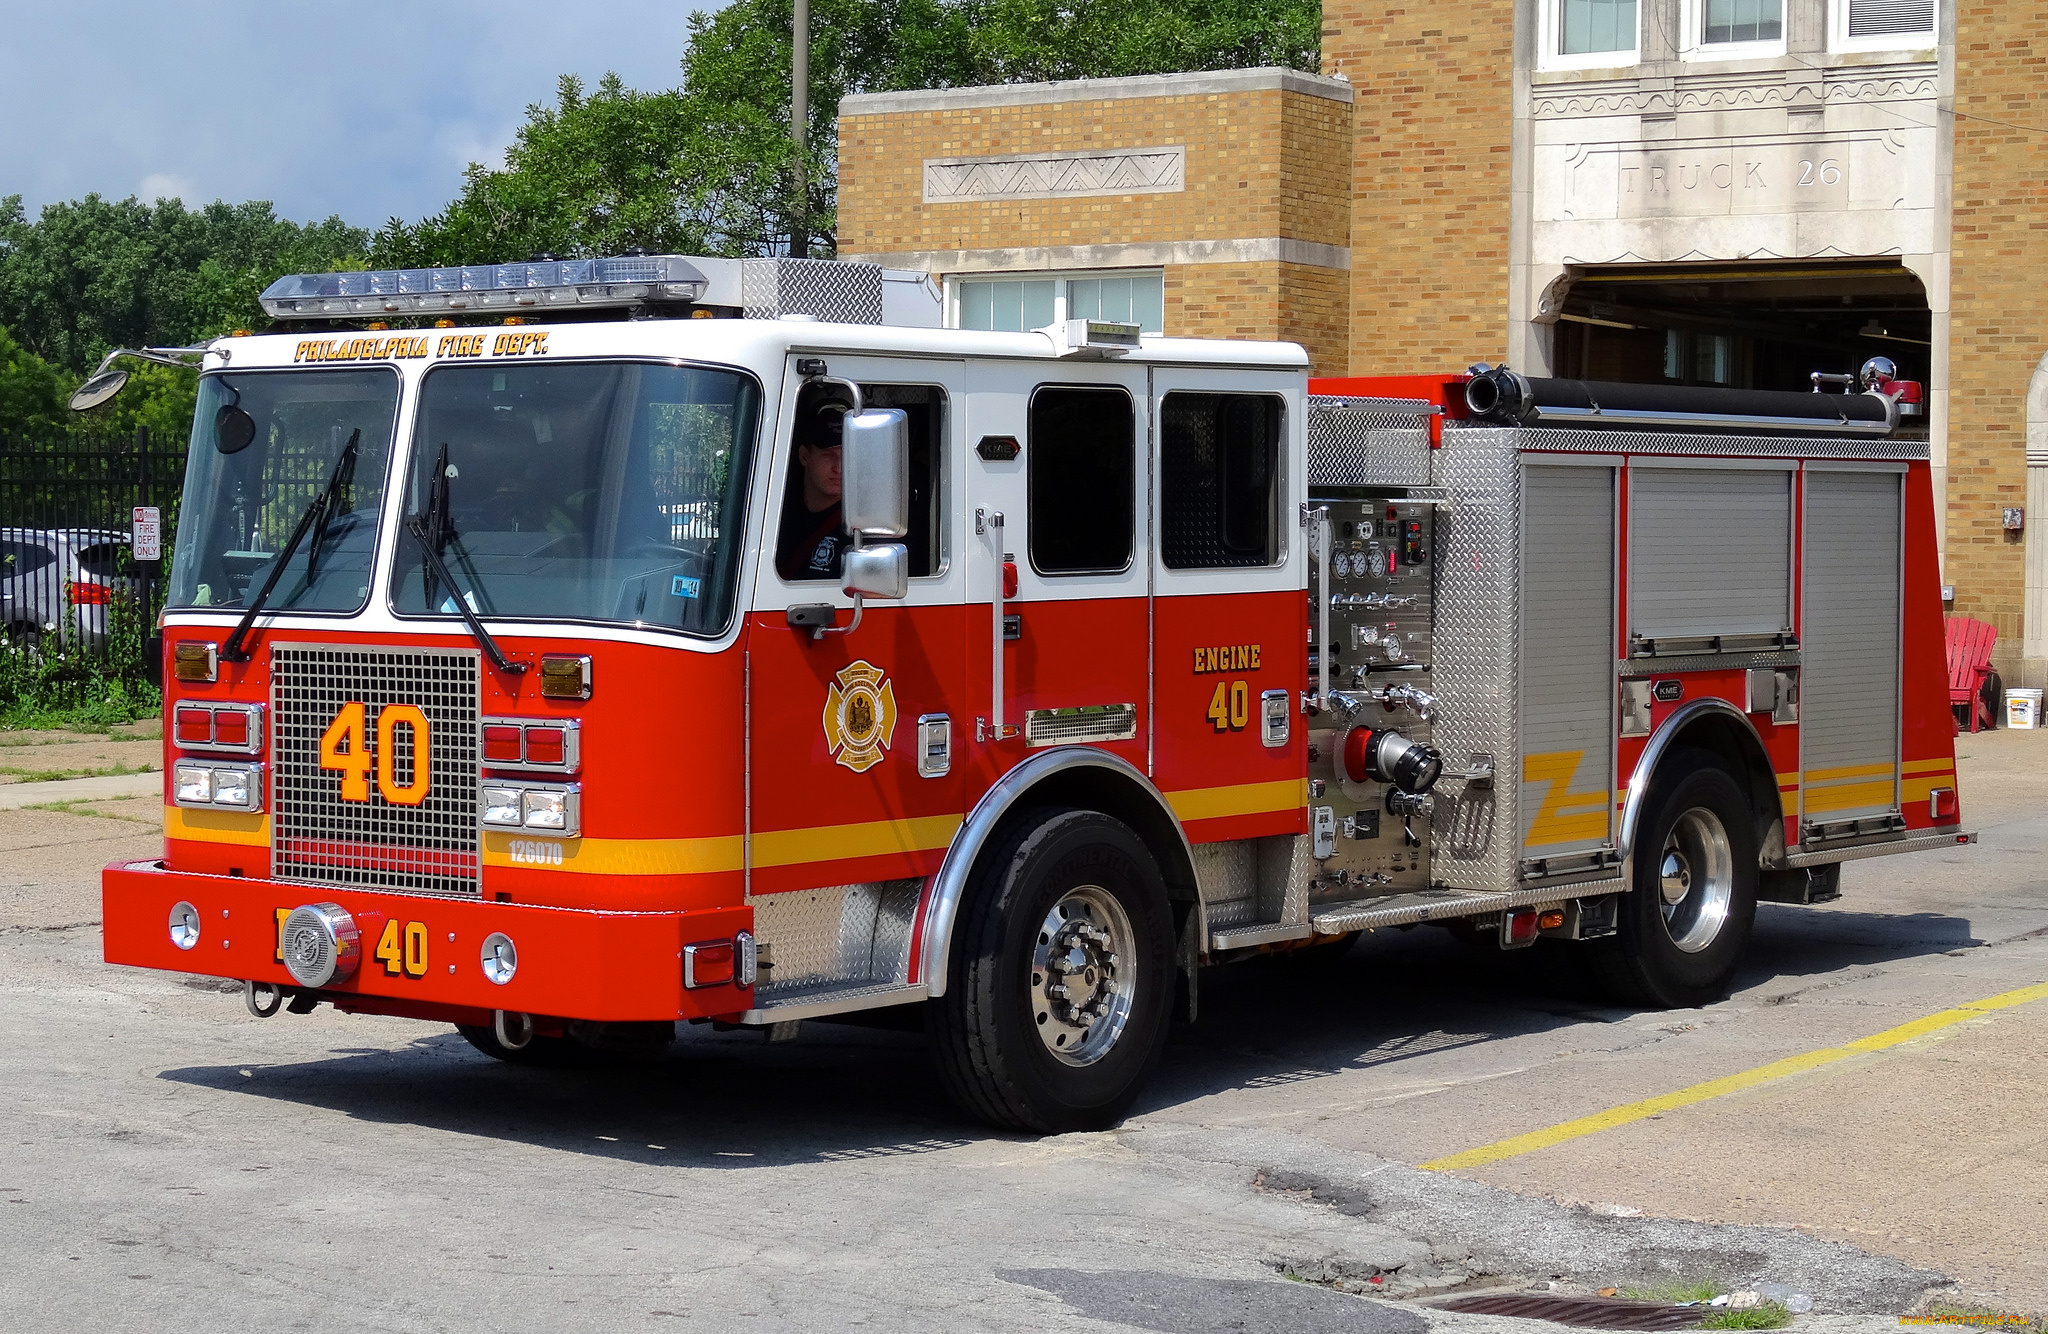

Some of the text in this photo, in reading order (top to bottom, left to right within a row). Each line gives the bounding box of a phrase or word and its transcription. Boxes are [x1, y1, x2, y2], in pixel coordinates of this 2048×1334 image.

[1621, 158, 1842, 193] TRUCK 26
[294, 332, 550, 362] PHILADELPHIA FIRE DEPT.
[984, 444, 1011, 454] KME
[134, 510, 144, 521] NO
[139, 524, 154, 533] FIRE
[137, 535, 156, 544] DEPT
[136, 546, 157, 555] ONLY
[689, 580, 698, 595] 14
[1193, 644, 1260, 674] ENGINE
[1660, 686, 1678, 694] KME
[1206, 680, 1249, 732] 40
[320, 701, 431, 806] 40
[508, 840, 563, 866] 126070
[375, 919, 428, 978] 40
